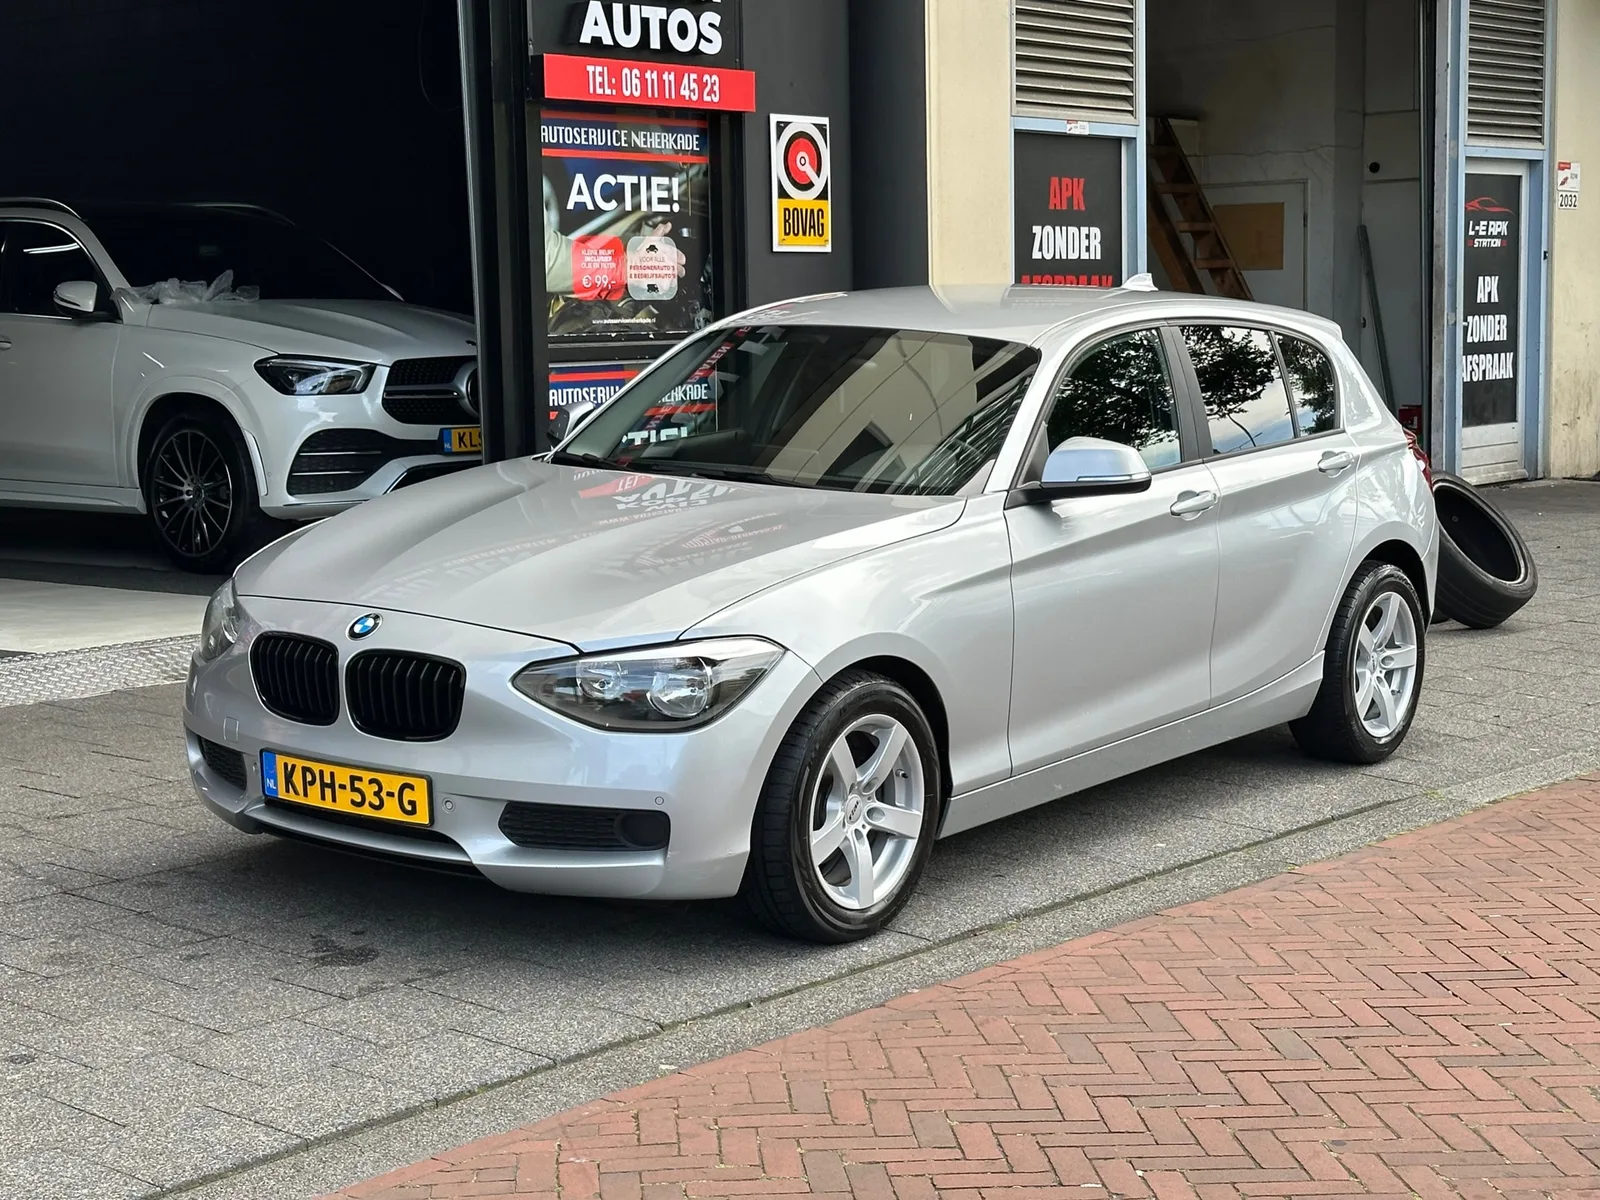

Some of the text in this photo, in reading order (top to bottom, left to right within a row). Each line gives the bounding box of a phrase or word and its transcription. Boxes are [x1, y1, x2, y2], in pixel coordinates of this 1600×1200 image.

[579, 0, 723, 55] AUTOS
[586, 65, 720, 103] TEL: 06 11 11 45 23
[631, 130, 700, 151] NEHERKADE
[566, 173, 680, 213] ACTIE!
[1048, 176, 1086, 211] APK
[1559, 194, 1577, 208] 2032
[783, 207, 825, 238] BOVAG
[1468, 220, 1509, 236] L-E APK
[1032, 225, 1102, 260] ZONDER
[1473, 238, 1502, 248] STATION
[582, 275, 617, 289] € 99,-
[1476, 275, 1499, 303] APK
[1466, 314, 1507, 343] ZONDER
[1461, 352, 1514, 382] AFSPRAAK
[266, 779, 277, 790] NL
[282, 761, 418, 817] KPH-53-G
